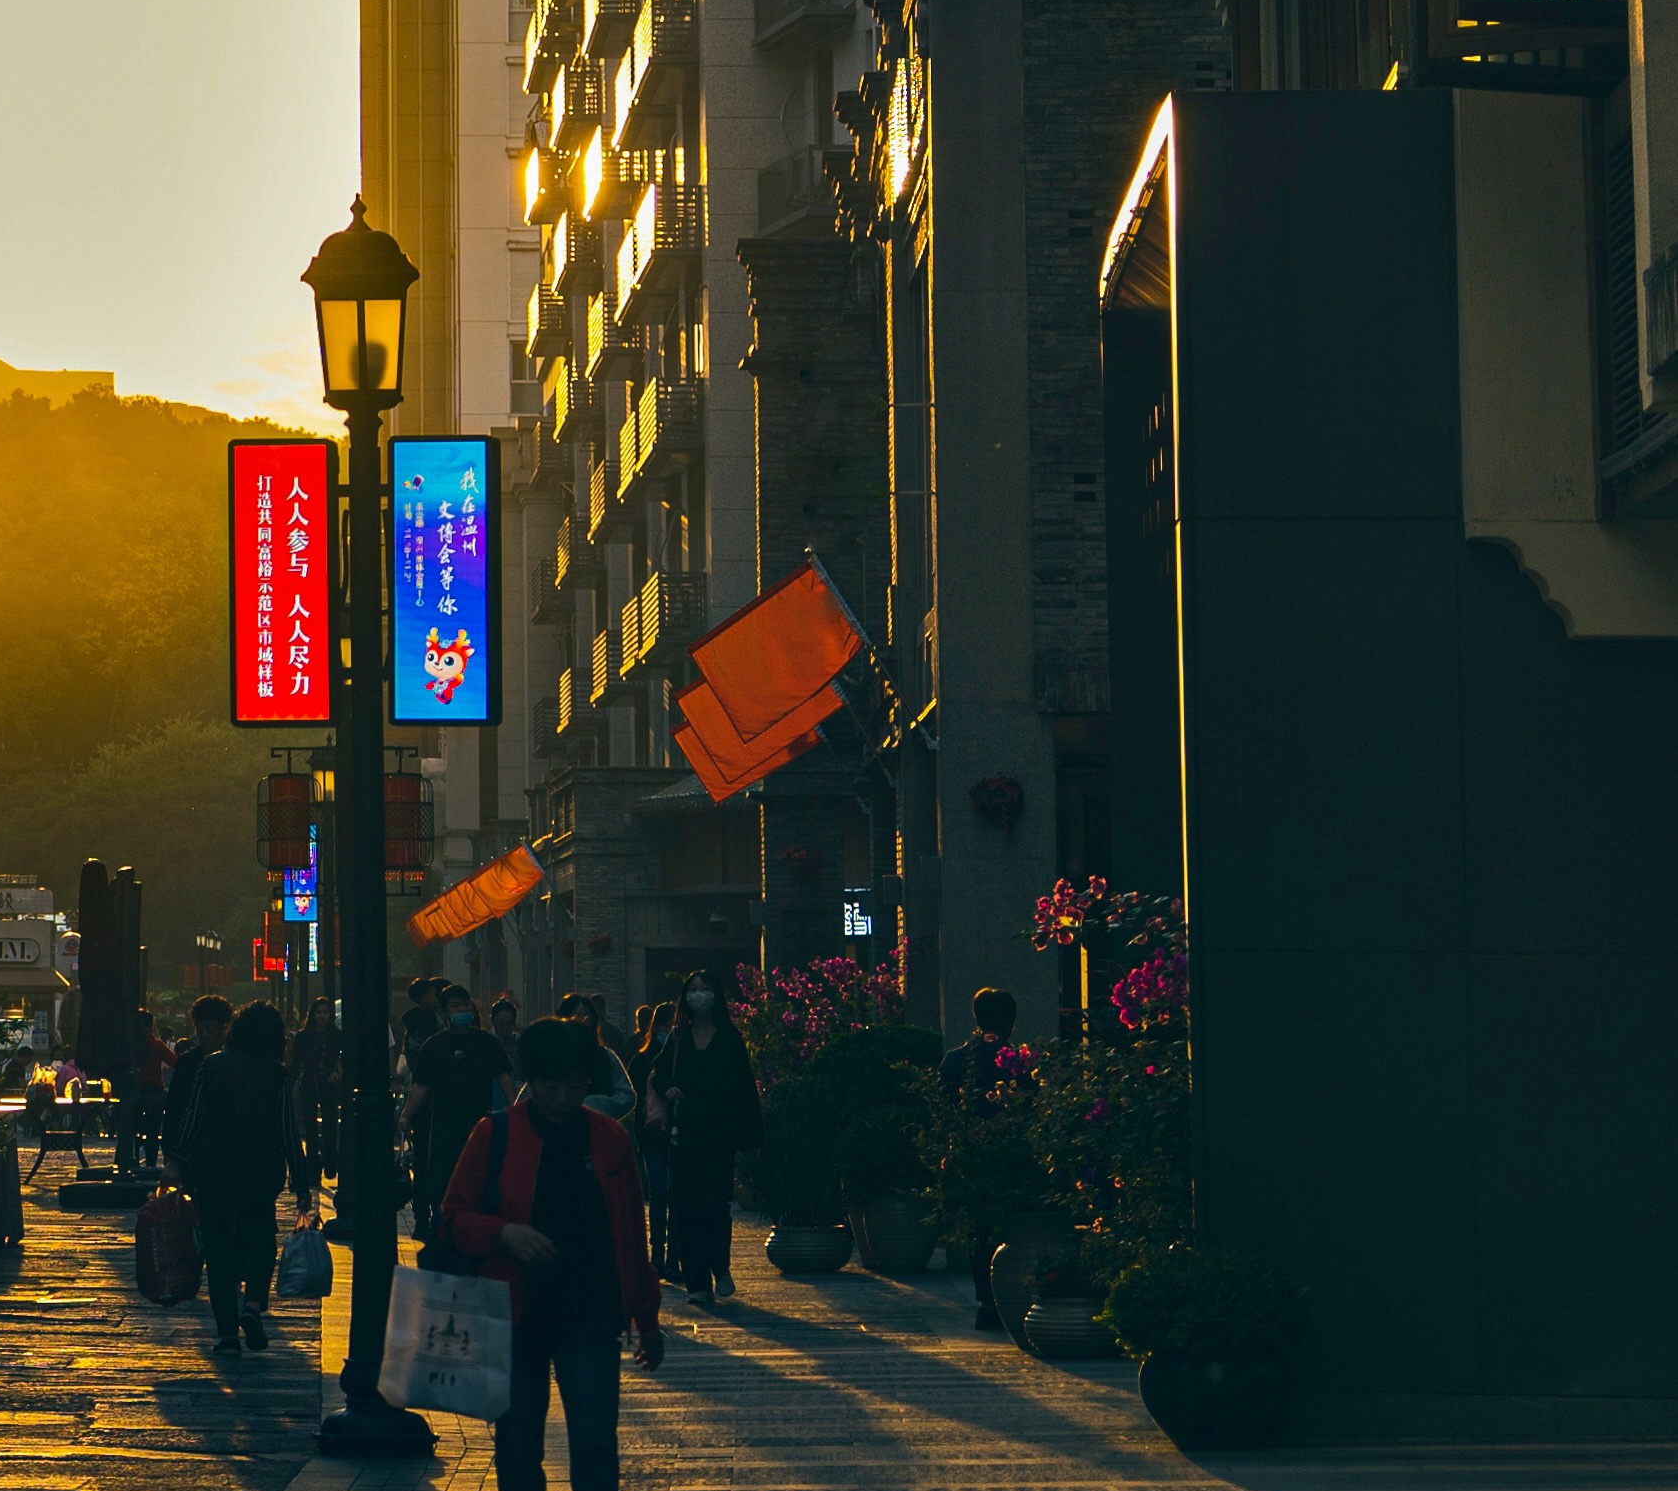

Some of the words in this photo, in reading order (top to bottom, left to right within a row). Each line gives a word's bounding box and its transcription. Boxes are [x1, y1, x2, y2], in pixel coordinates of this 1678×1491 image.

[286, 476, 310, 578] 人人参与
[436, 500, 459, 616] 文博会等你
[460, 466, 480, 558] 我在温州
[256, 475, 274, 698] 打造共同富裕示范区市域样板
[287, 594, 311, 695] 人人尽力
